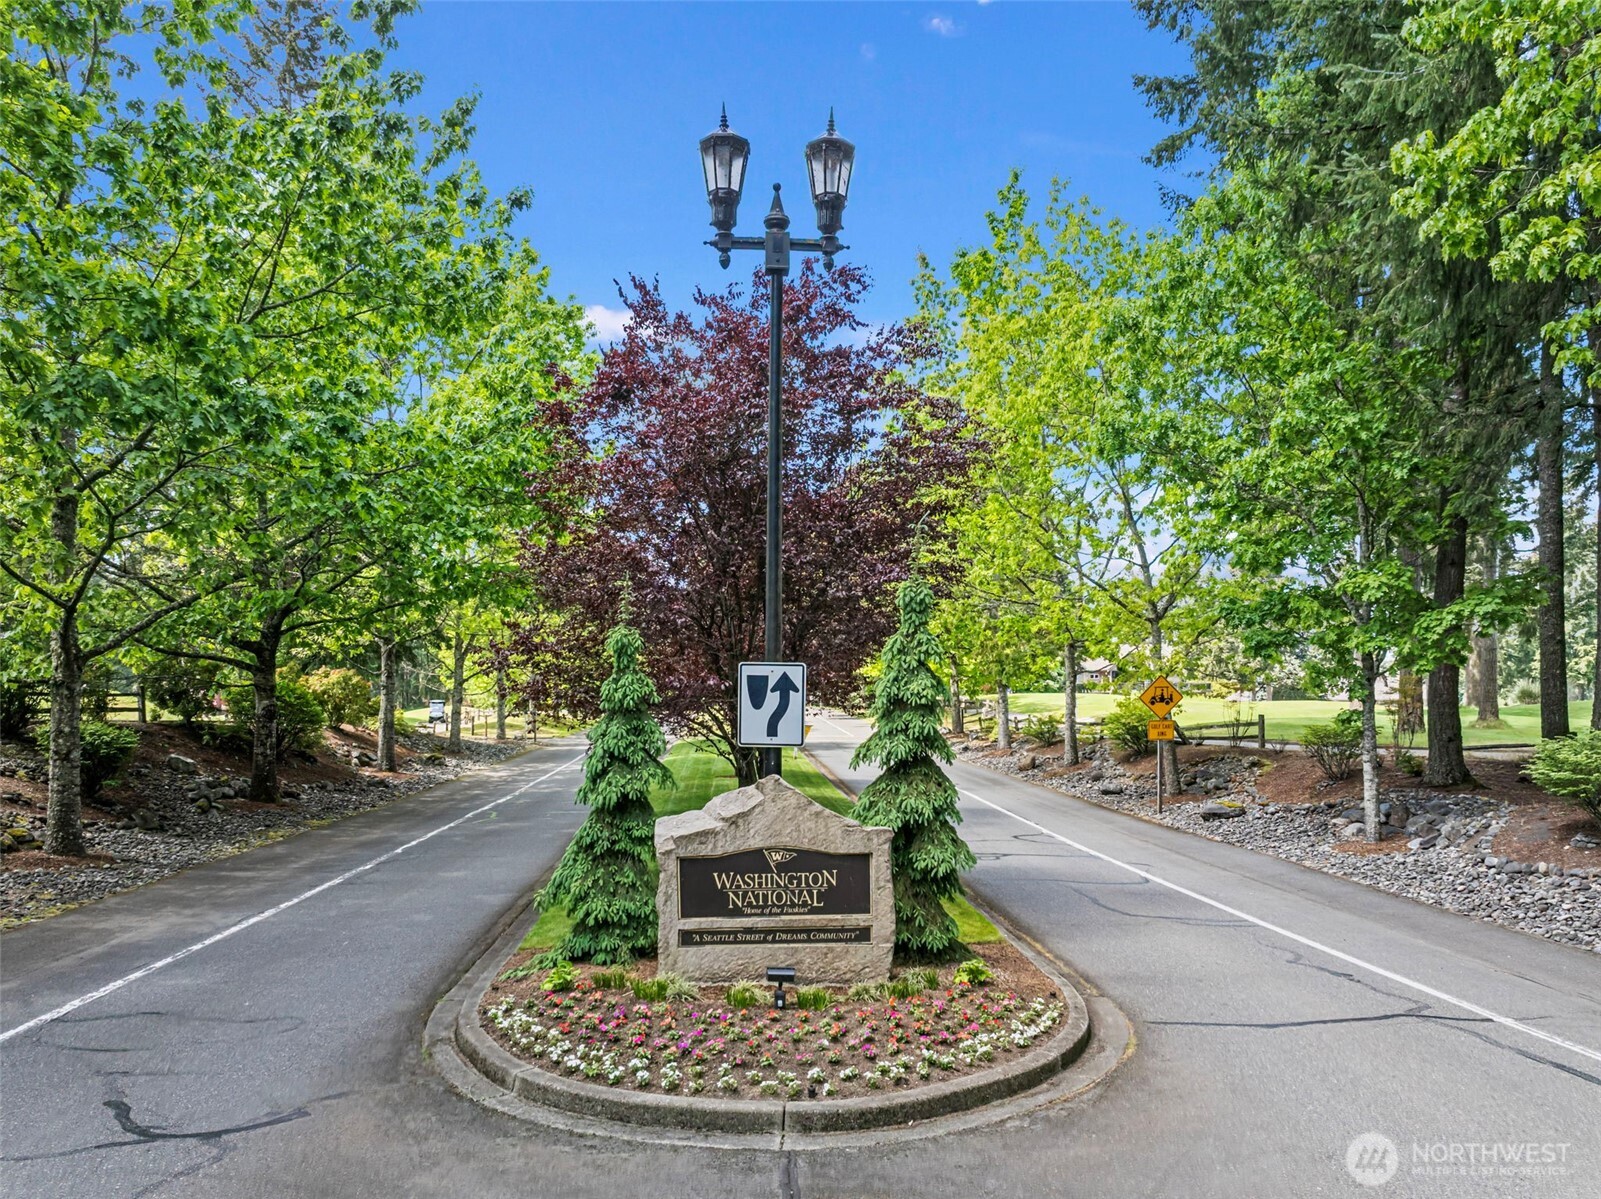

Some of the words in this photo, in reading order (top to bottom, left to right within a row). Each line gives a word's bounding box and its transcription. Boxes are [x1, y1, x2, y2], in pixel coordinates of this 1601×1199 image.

[770, 852, 784, 860] W
[713, 869, 838, 889] WASHINGTON
[728, 889, 824, 909] NATIONAL
[763, 906, 772, 914] of
[702, 934, 735, 942] SEATTLE
[736, 933, 765, 941] STREET
[766, 933, 774, 942] of
[775, 932, 808, 941] DREAMS
